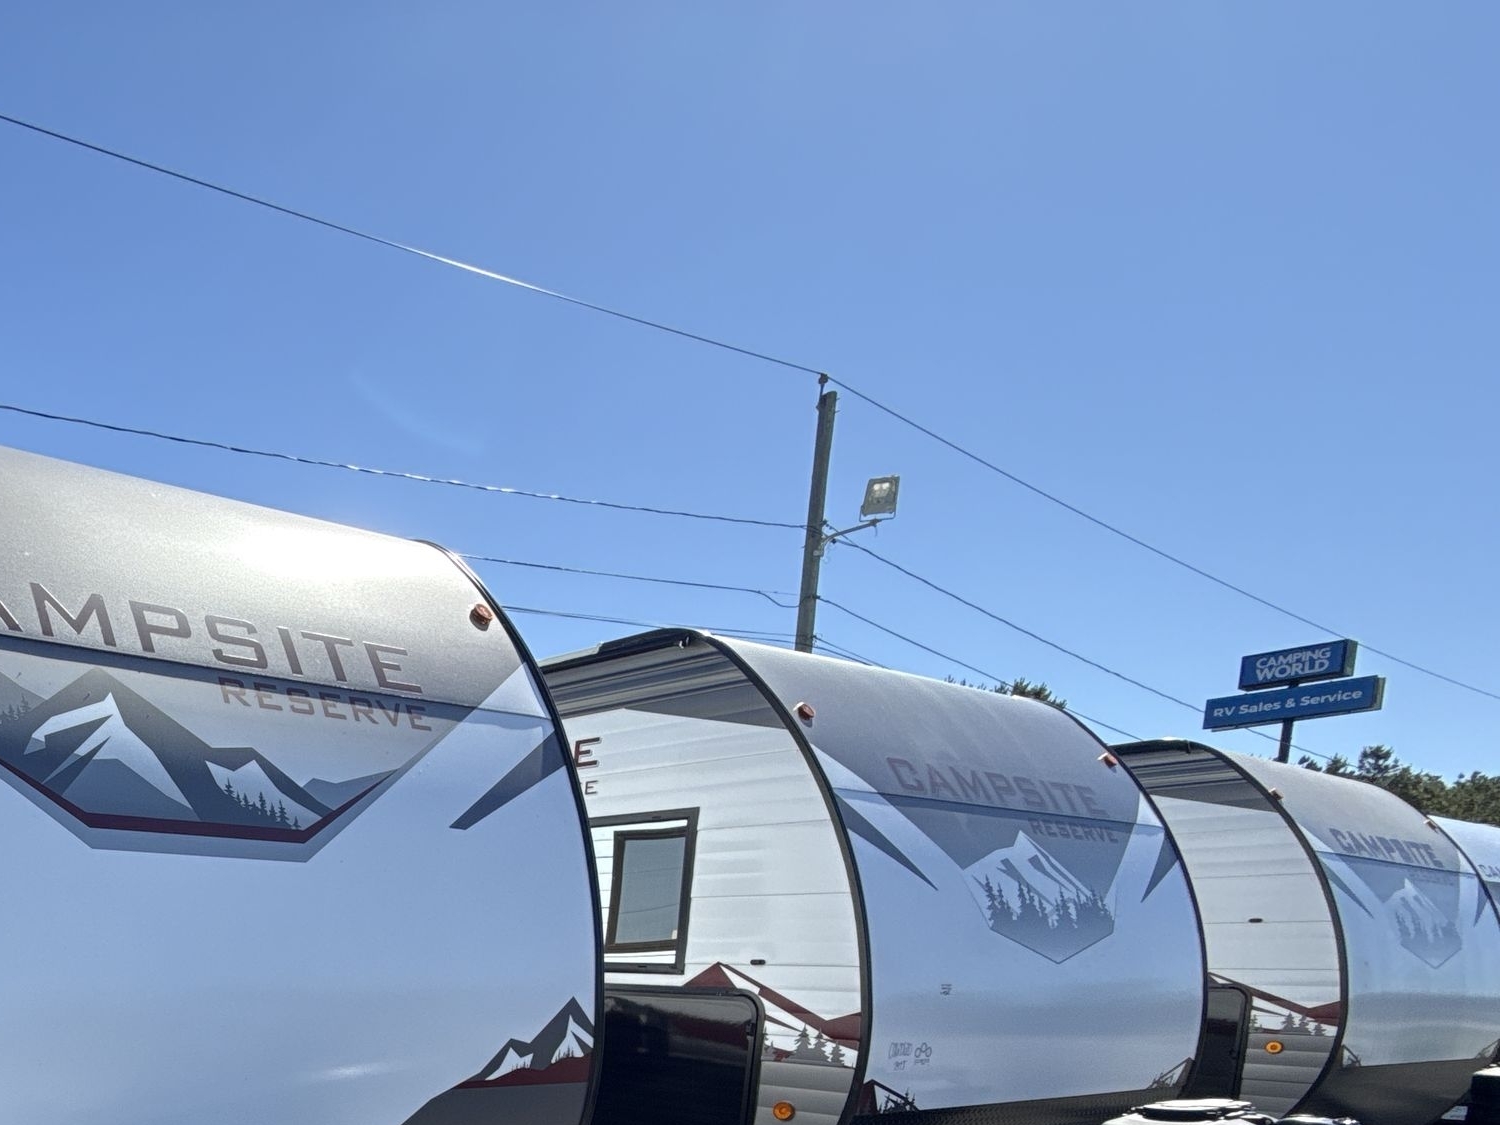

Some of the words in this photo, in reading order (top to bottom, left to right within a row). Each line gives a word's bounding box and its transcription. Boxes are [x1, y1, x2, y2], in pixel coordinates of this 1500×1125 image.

[1256, 647, 1332, 669] CAMPING
[1256, 659, 1330, 681] WORLD
[217, 676, 433, 732] RESERVE
[1213, 706, 1236, 718] RV
[1238, 700, 1283, 715] Sales
[1285, 697, 1297, 709] &
[1300, 689, 1364, 707] Service
[886, 756, 1111, 818] CAMPSITE
[1028, 818, 1119, 844] RESERVE
[1329, 828, 1445, 869] CAMPSITE
